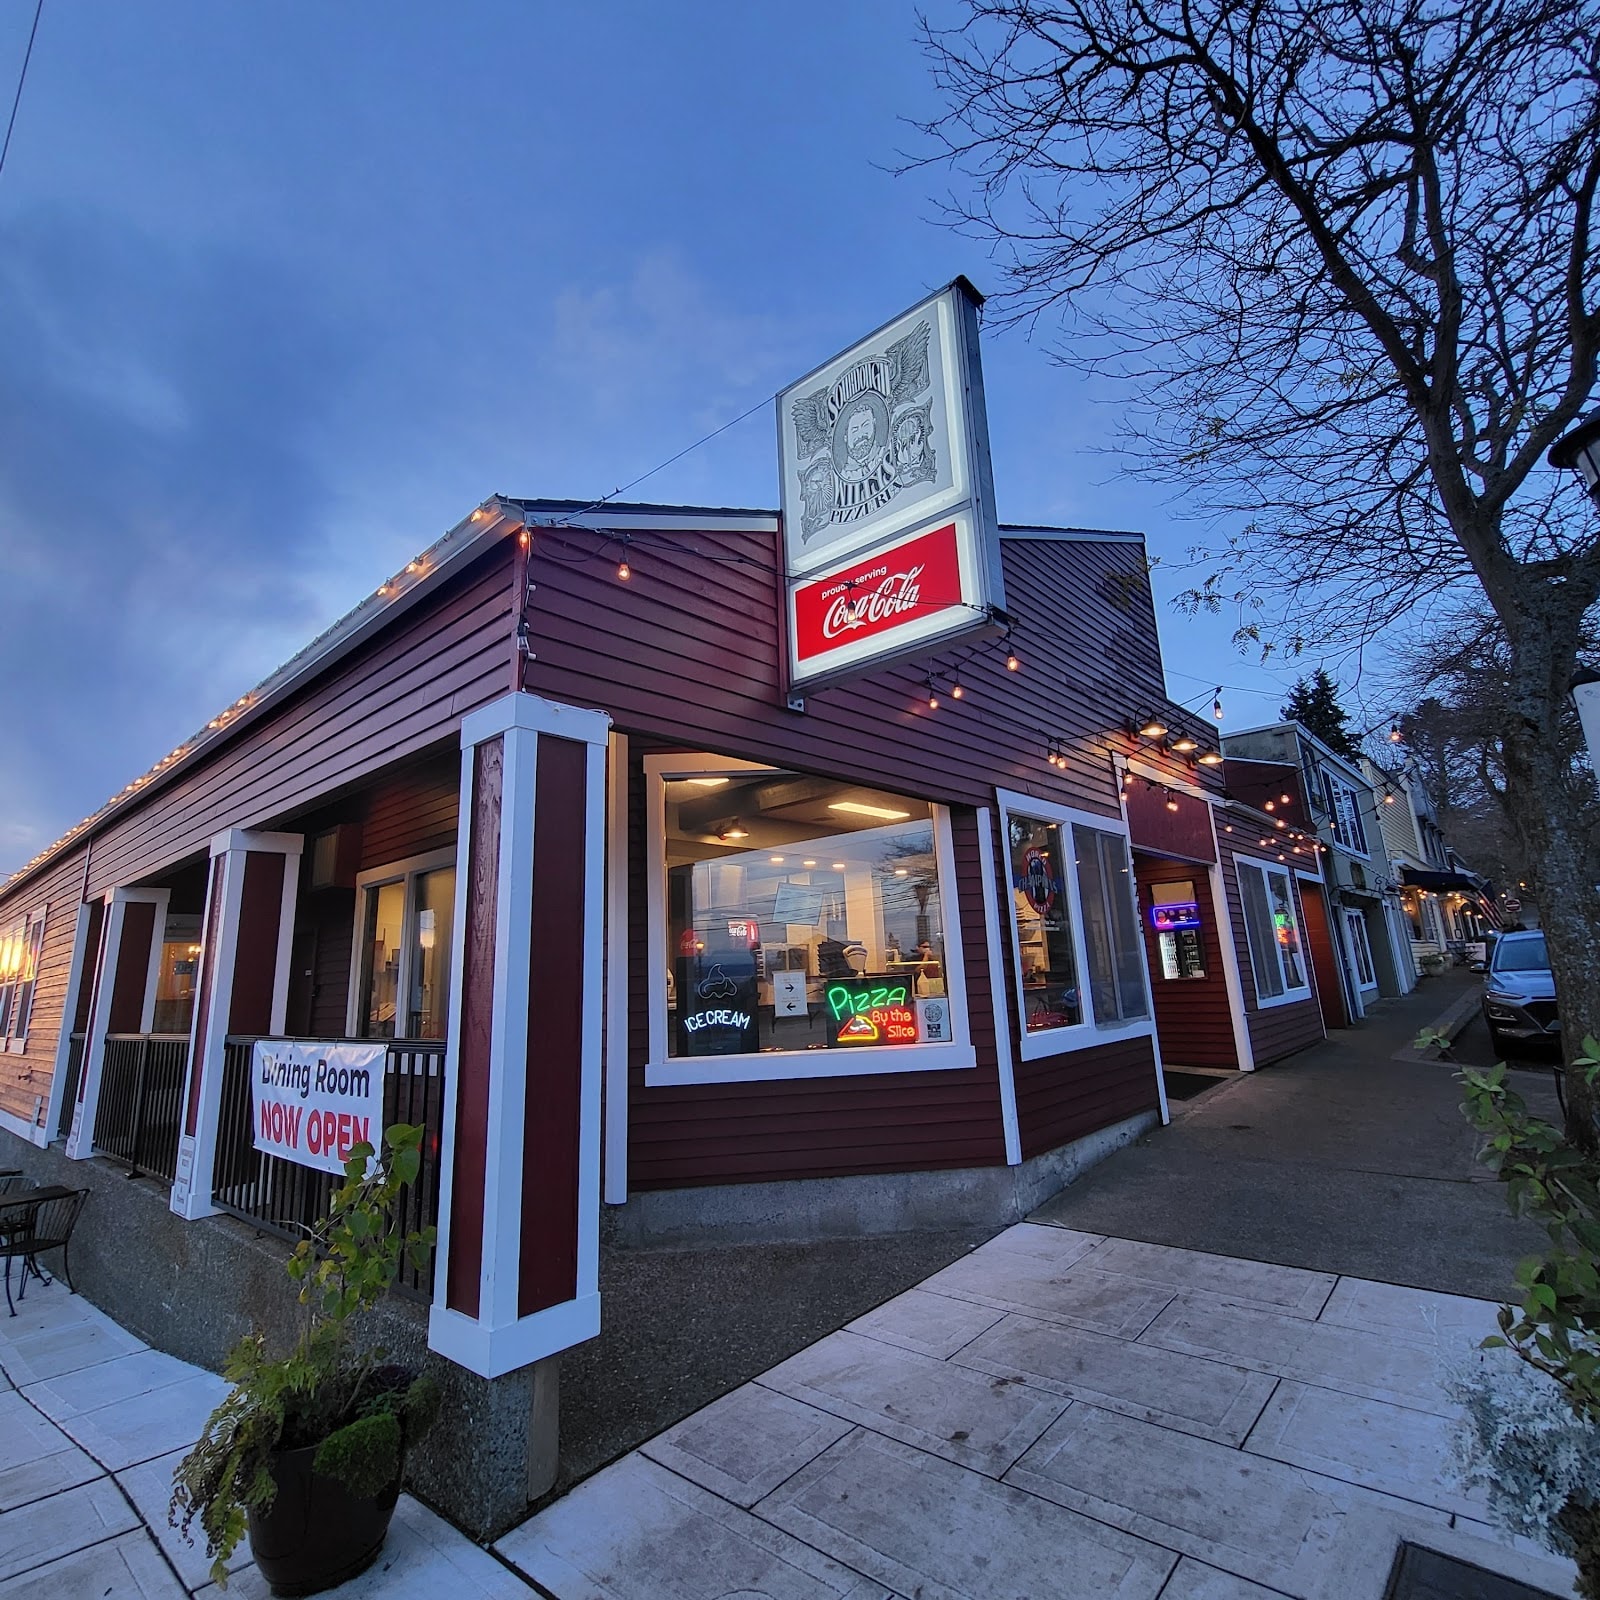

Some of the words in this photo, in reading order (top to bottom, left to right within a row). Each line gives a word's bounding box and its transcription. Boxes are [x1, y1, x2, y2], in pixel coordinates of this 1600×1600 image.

[830, 478, 902, 523] PIZZERIA
[821, 580, 853, 600] proud
[855, 566, 887, 585] serving
[823, 563, 925, 638] Coca-Cola
[684, 1011, 706, 1032] ICE
[706, 1009, 751, 1030] CREAM
[872, 1010, 888, 1024] By
[890, 1008, 912, 1023] the
[887, 1025, 915, 1039] Slice
[261, 1054, 311, 1098] Dining
[315, 1059, 370, 1098] Room
[261, 1099, 303, 1149] NOW
[306, 1109, 370, 1163] OPEN
